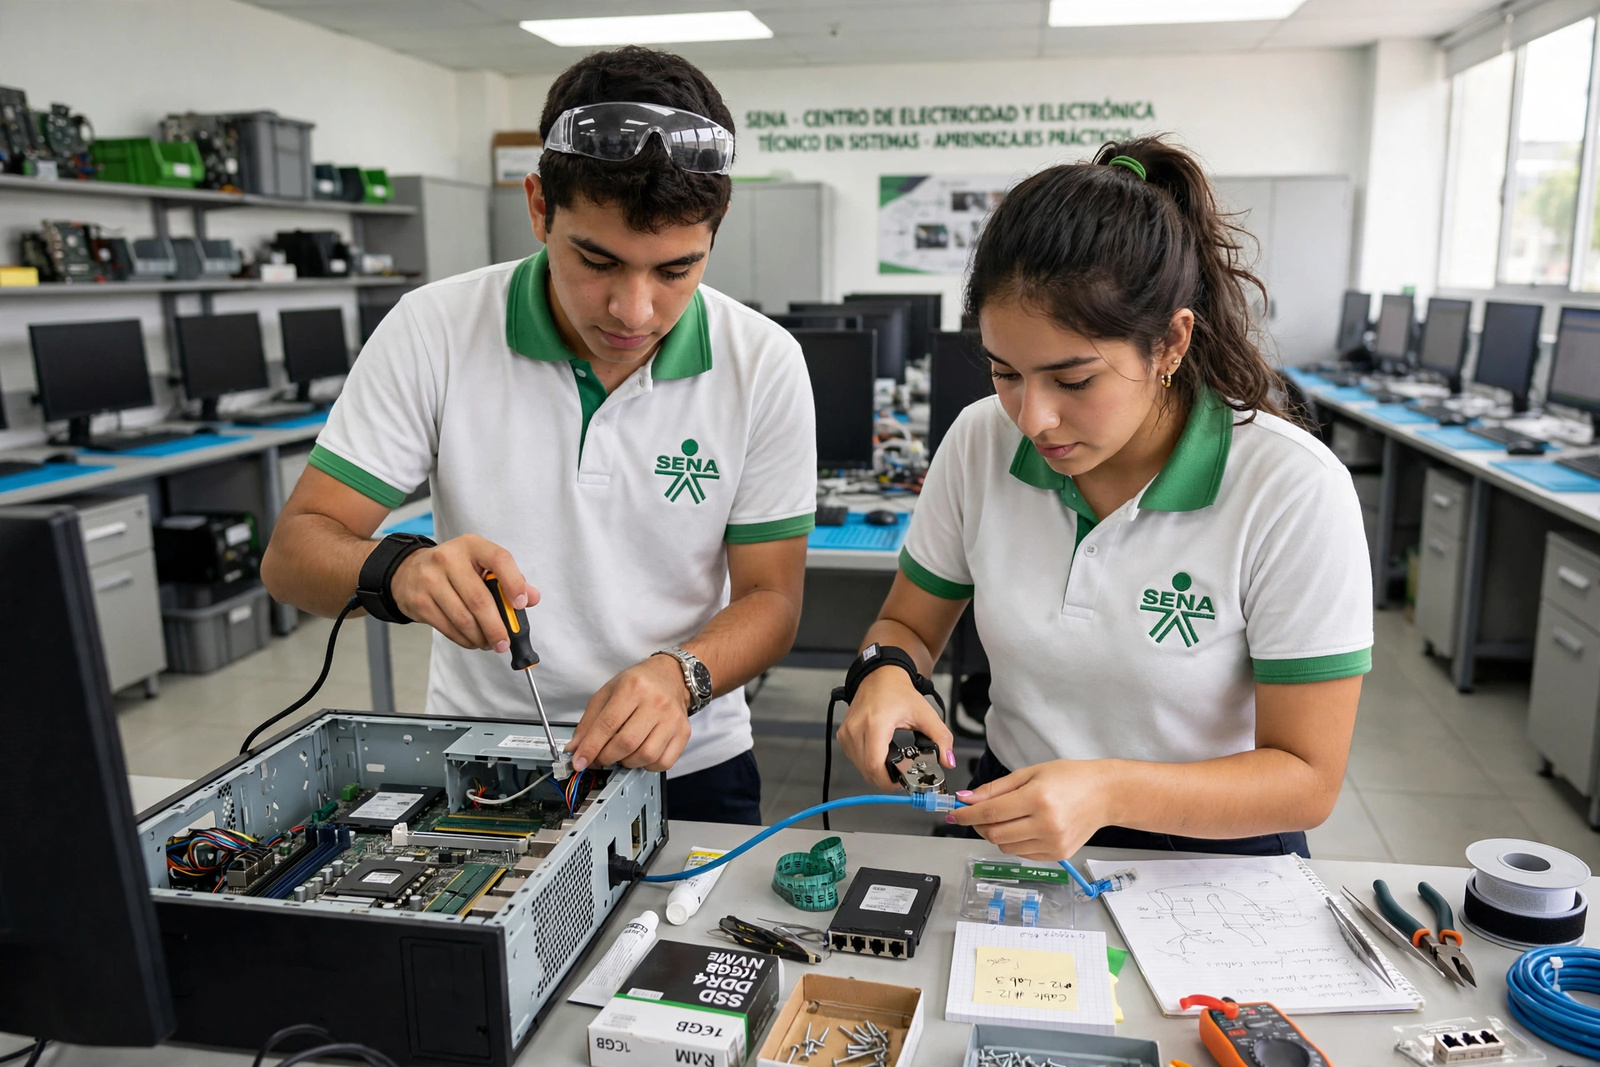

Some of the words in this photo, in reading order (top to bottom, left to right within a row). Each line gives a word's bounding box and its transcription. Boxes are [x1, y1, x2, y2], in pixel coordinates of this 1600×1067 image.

[746, 110, 787, 128] SENA
[803, 108, 869, 127] CENTRO
[873, 107, 894, 126] DE
[899, 104, 1018, 125] ELECTRICIDAD
[1022, 104, 1034, 122] Y
[1039, 97, 1155, 121] ELECTRÓNICA
[758, 131, 821, 152] TÉCNICO
[825, 133, 844, 151] EN
[849, 132, 919, 151] SISTEMAS
[934, 129, 1043, 148] APRENDIZAJES
[656, 455, 719, 473] SENA
[1143, 589, 1215, 613] SENA
[707, 951, 765, 970] NVME
[692, 972, 754, 994] DDR4
[698, 989, 744, 1008] SSD
